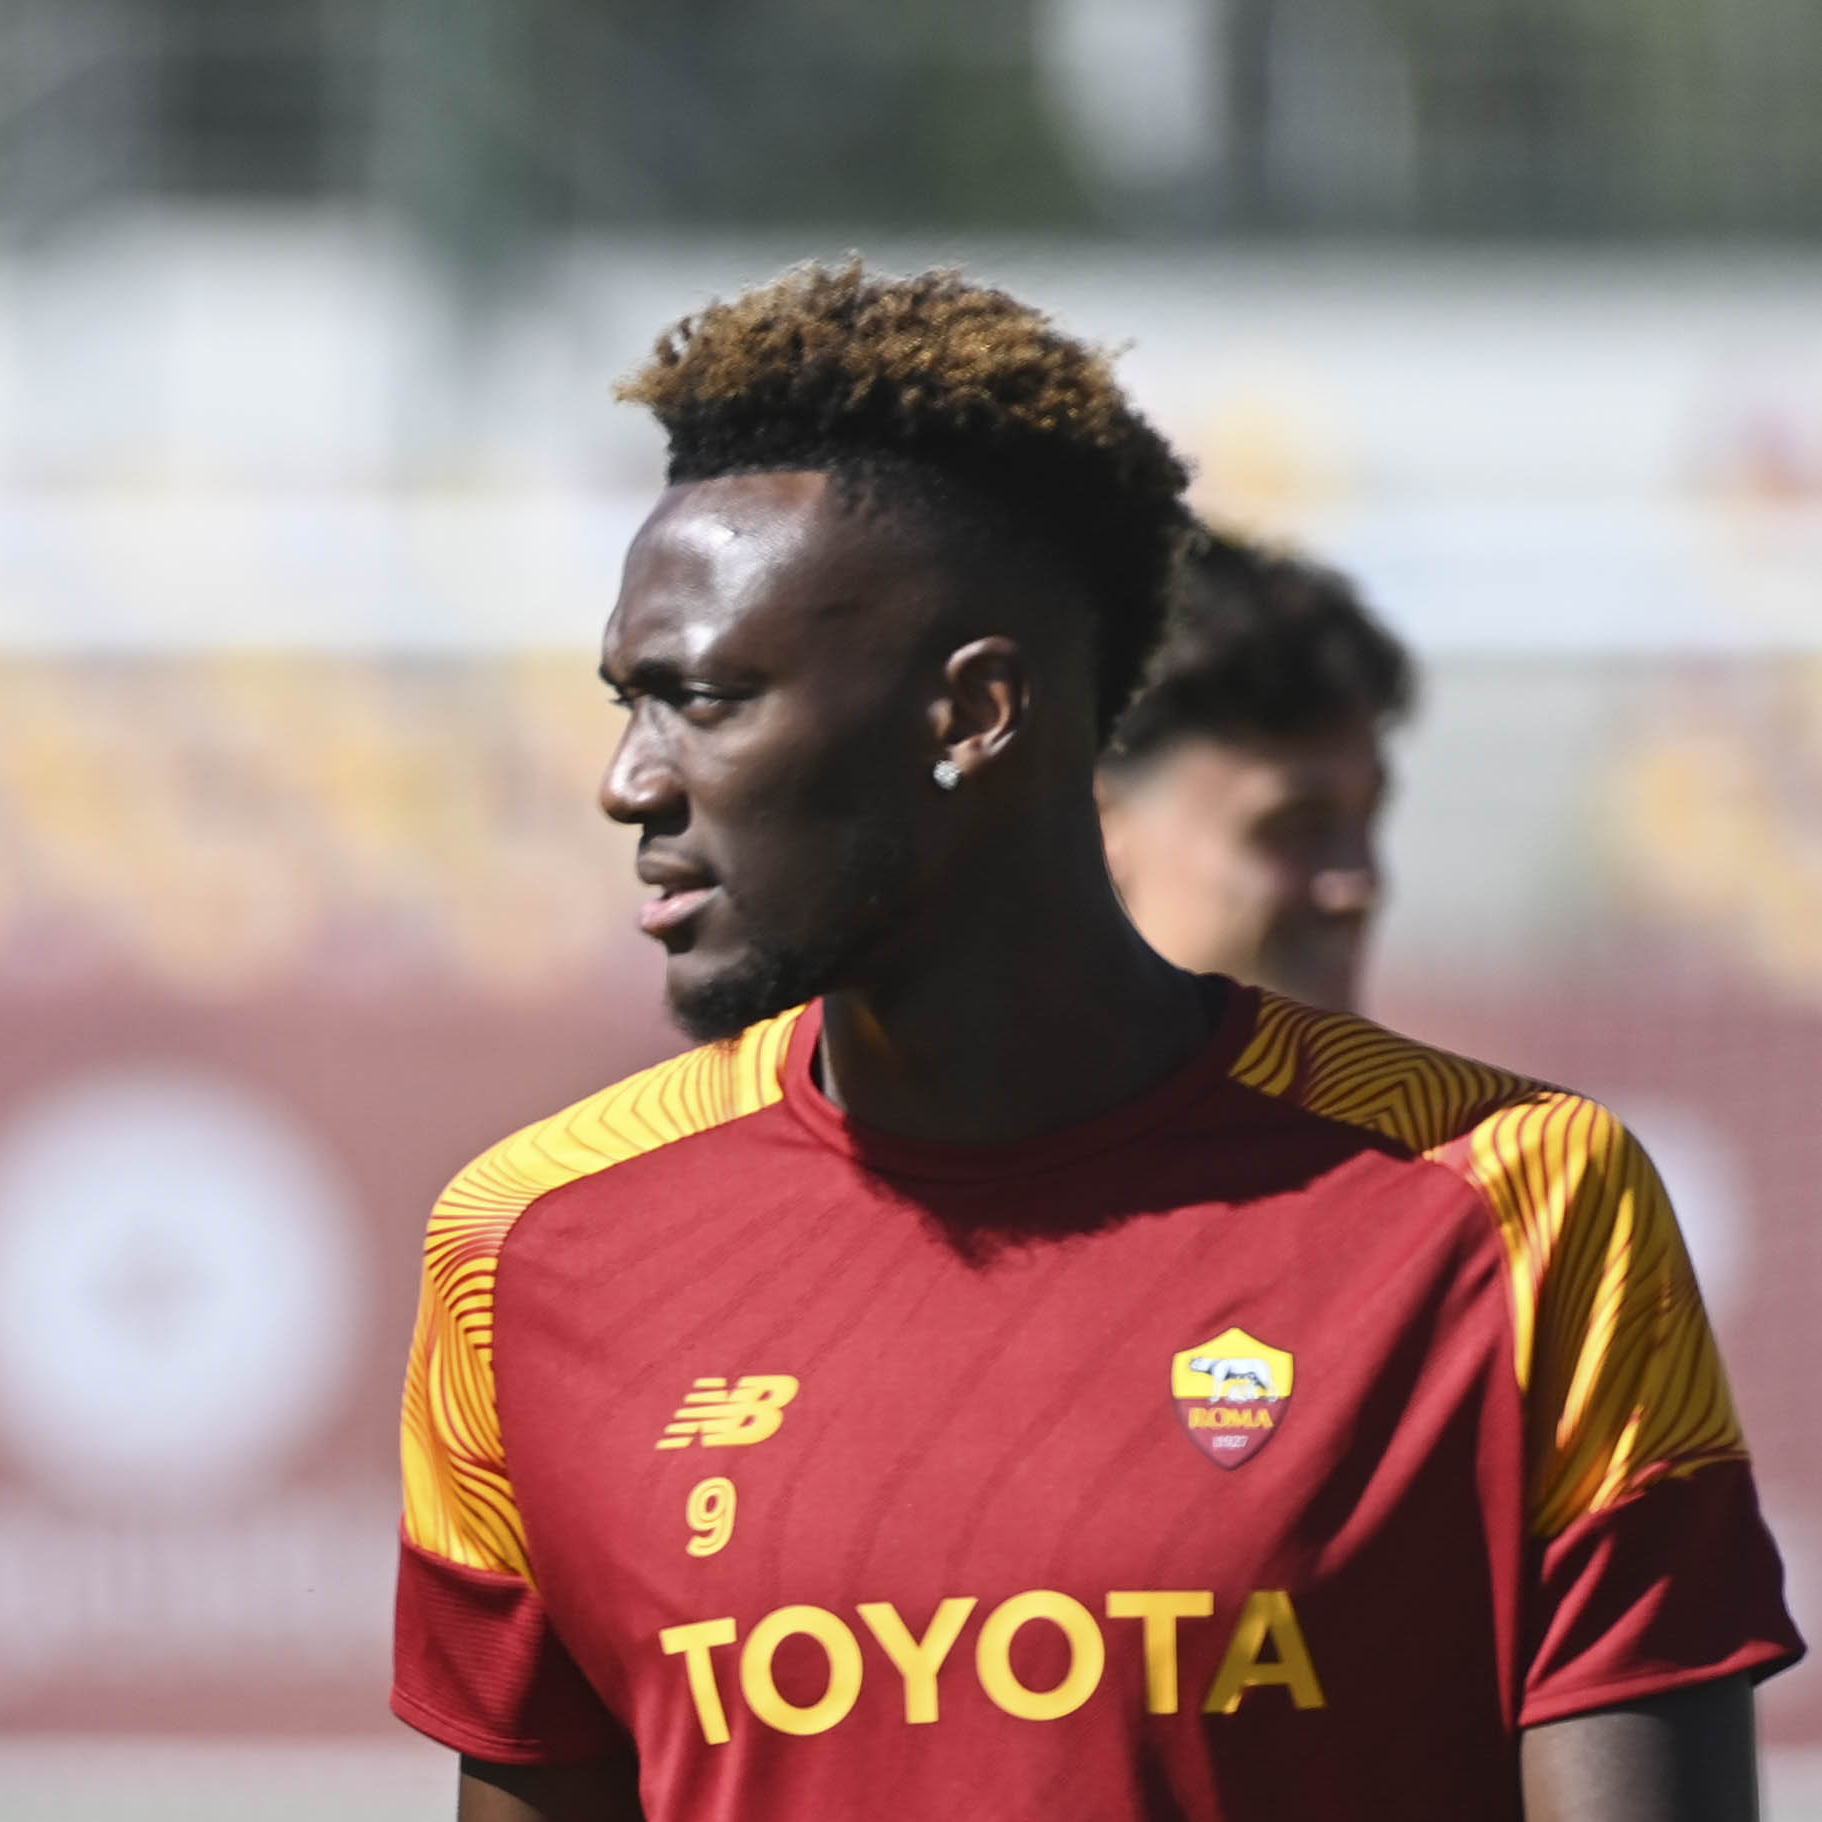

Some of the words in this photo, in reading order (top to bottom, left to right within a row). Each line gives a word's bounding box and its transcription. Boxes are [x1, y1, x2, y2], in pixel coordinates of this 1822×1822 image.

[1188, 1407, 1275, 1429] ROMA
[686, 1477, 737, 1557] 9
[660, 1590, 1326, 1745] TOYOTA
